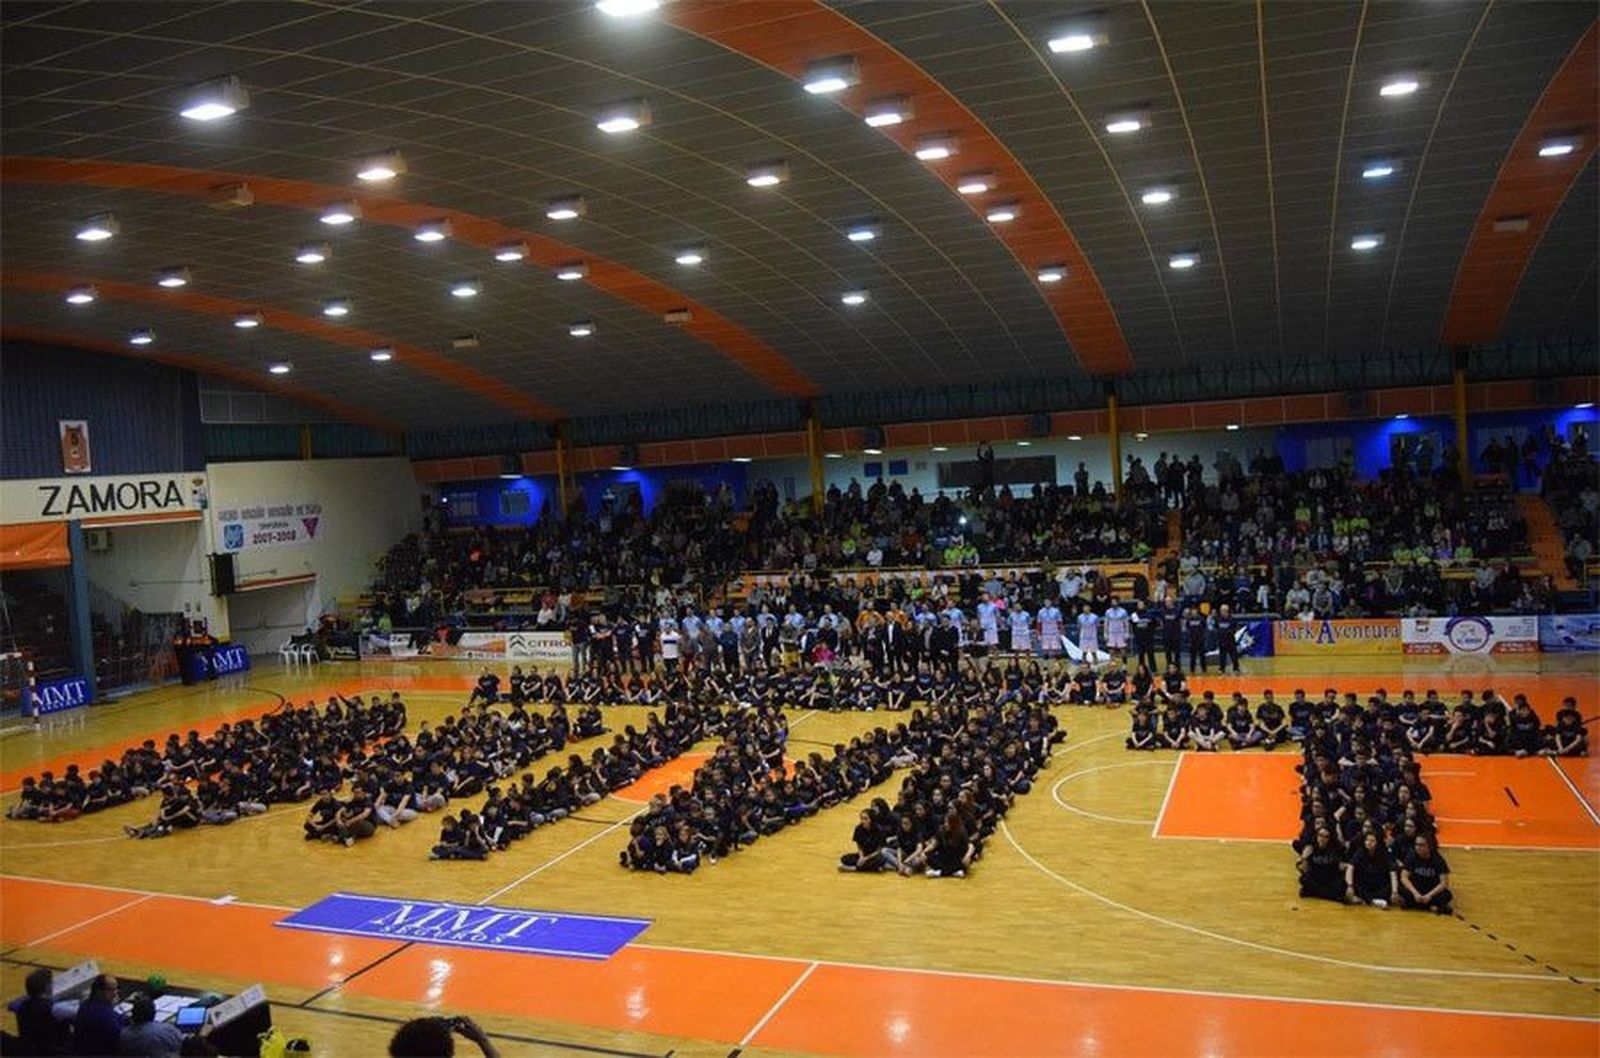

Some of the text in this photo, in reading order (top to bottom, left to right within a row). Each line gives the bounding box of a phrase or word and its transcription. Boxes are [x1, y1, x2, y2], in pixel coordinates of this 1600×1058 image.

[38, 480, 185, 516] ZAMORA
[528, 639, 571, 648] CITRO
[32, 681, 86, 706] MMT
[372, 904, 558, 938] MMT
[379, 926, 507, 943] SEGUROS
